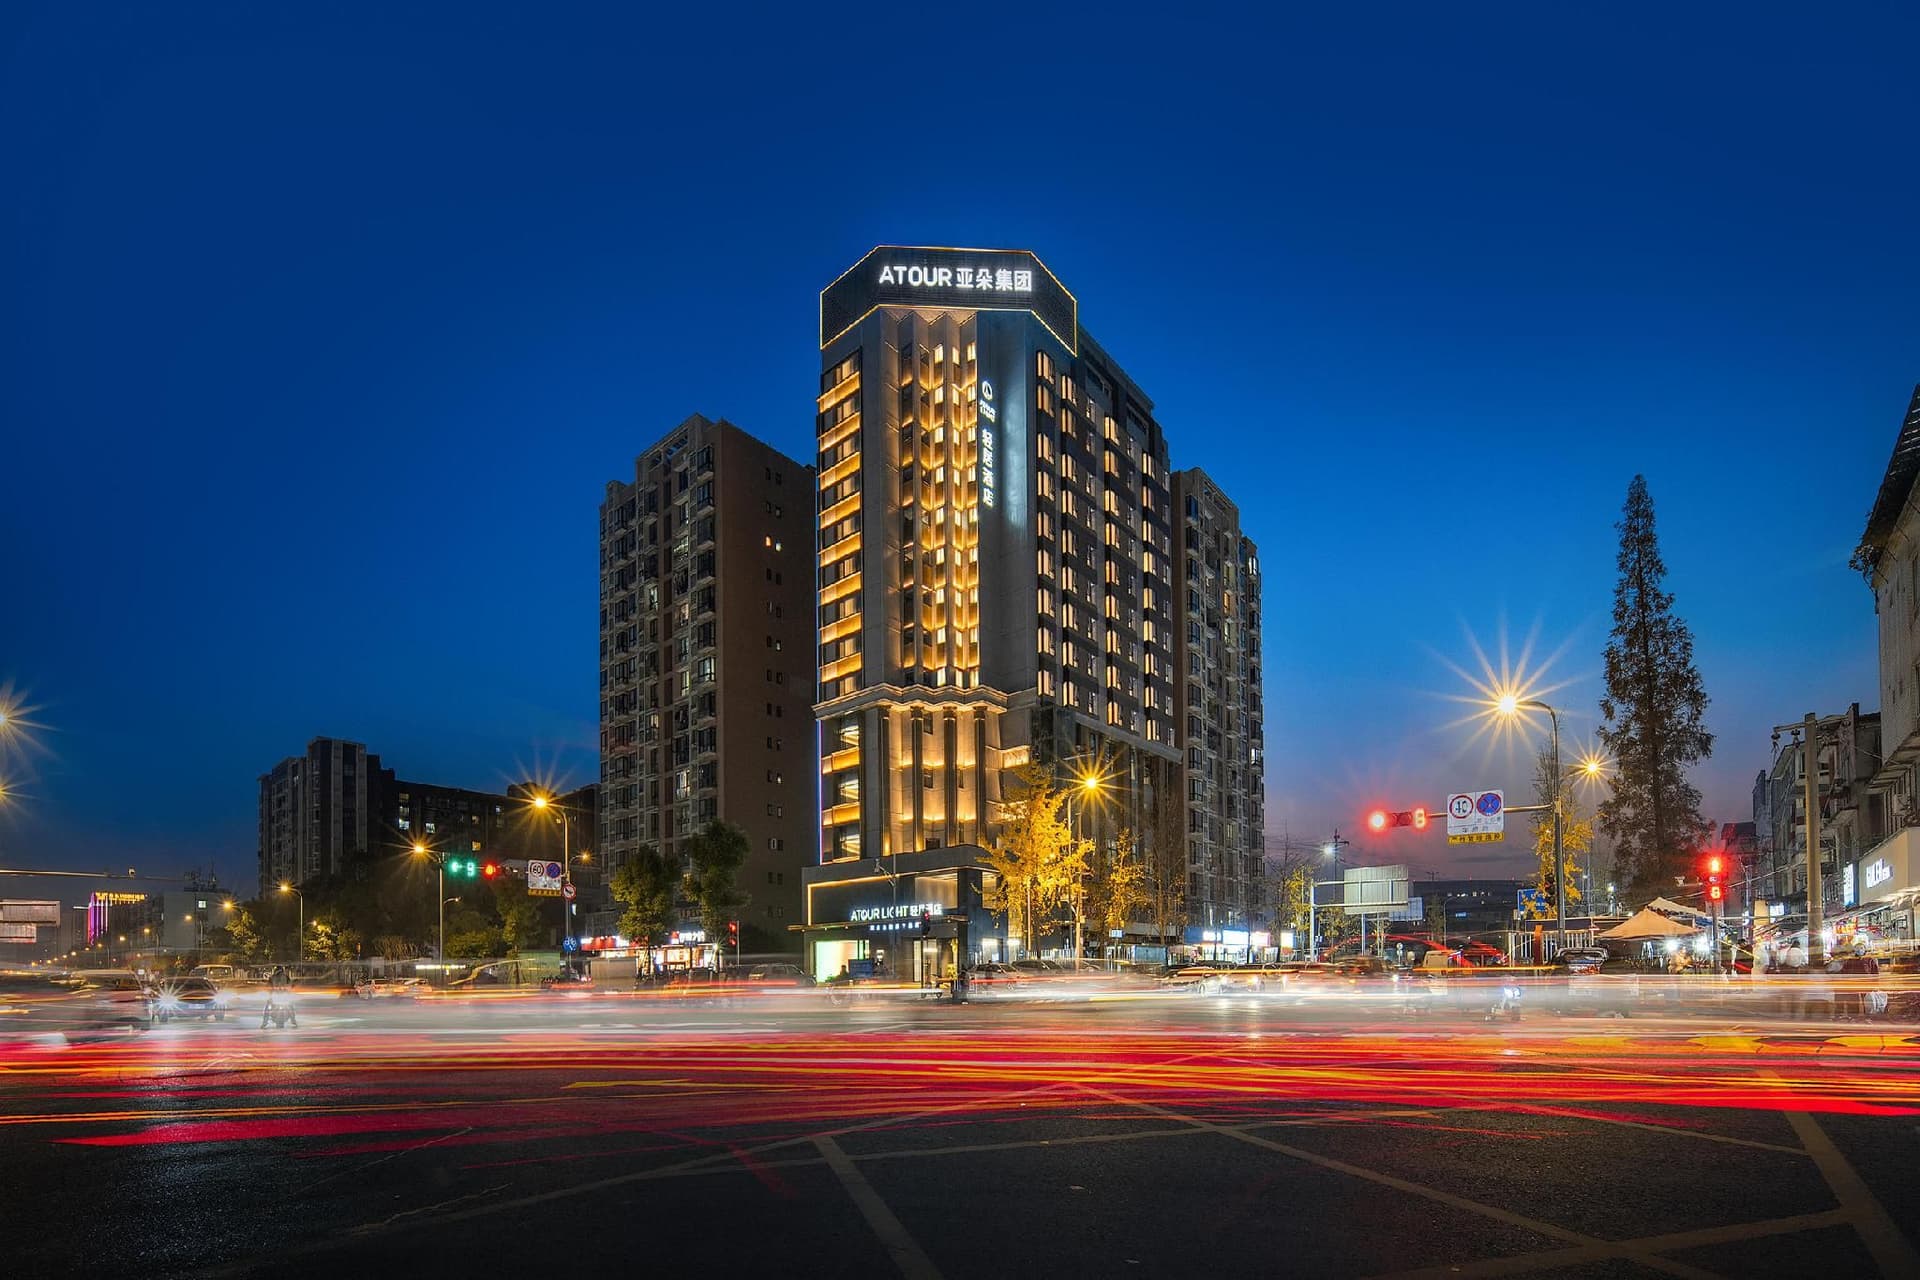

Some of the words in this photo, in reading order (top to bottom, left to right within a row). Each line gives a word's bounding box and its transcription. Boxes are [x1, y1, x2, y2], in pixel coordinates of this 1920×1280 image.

[879, 266, 952, 287] ATOUR
[956, 267, 1032, 291] 亚朵集团
[851, 907, 880, 921] ATOUR
